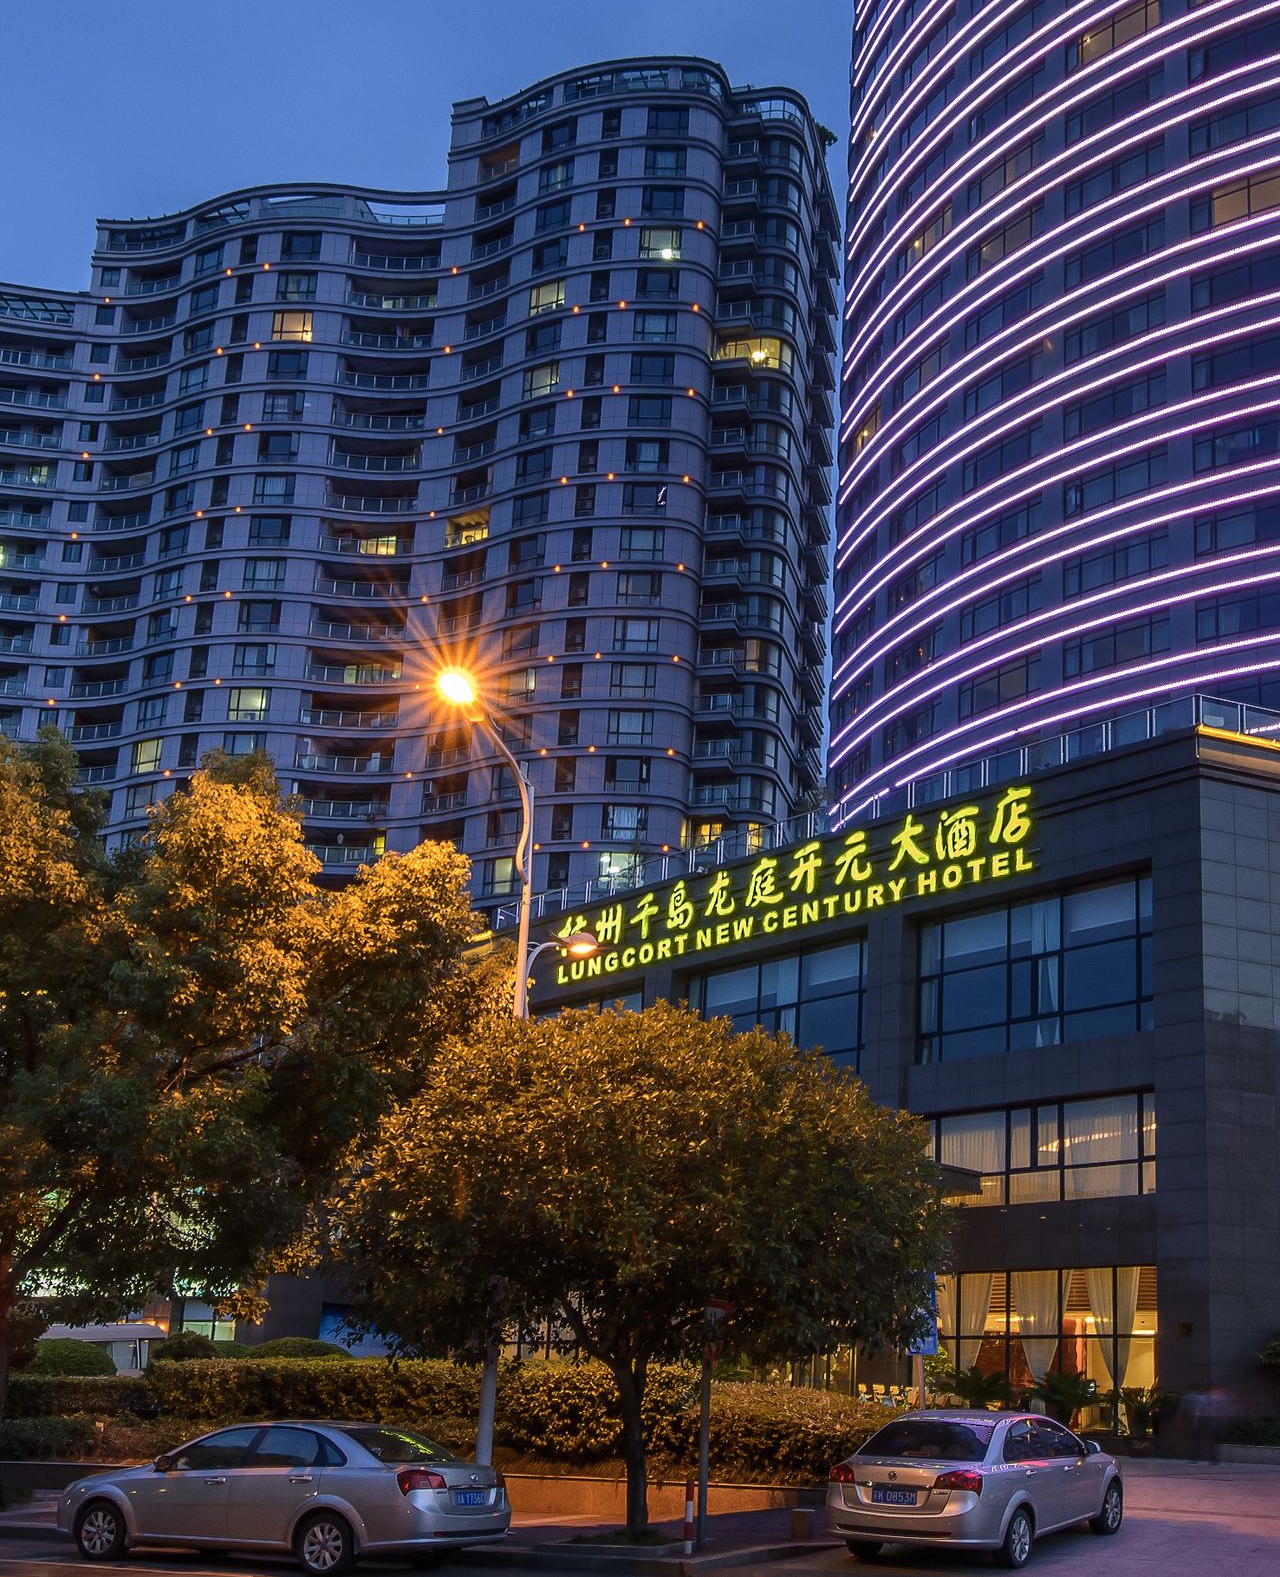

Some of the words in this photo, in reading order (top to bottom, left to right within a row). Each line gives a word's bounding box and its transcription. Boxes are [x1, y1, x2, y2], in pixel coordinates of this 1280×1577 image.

[557, 934, 688, 985] LUNGCORT
[696, 915, 753, 950] NEW
[763, 877, 907, 934] CENTURY
[917, 848, 1034, 897] HOTEL
